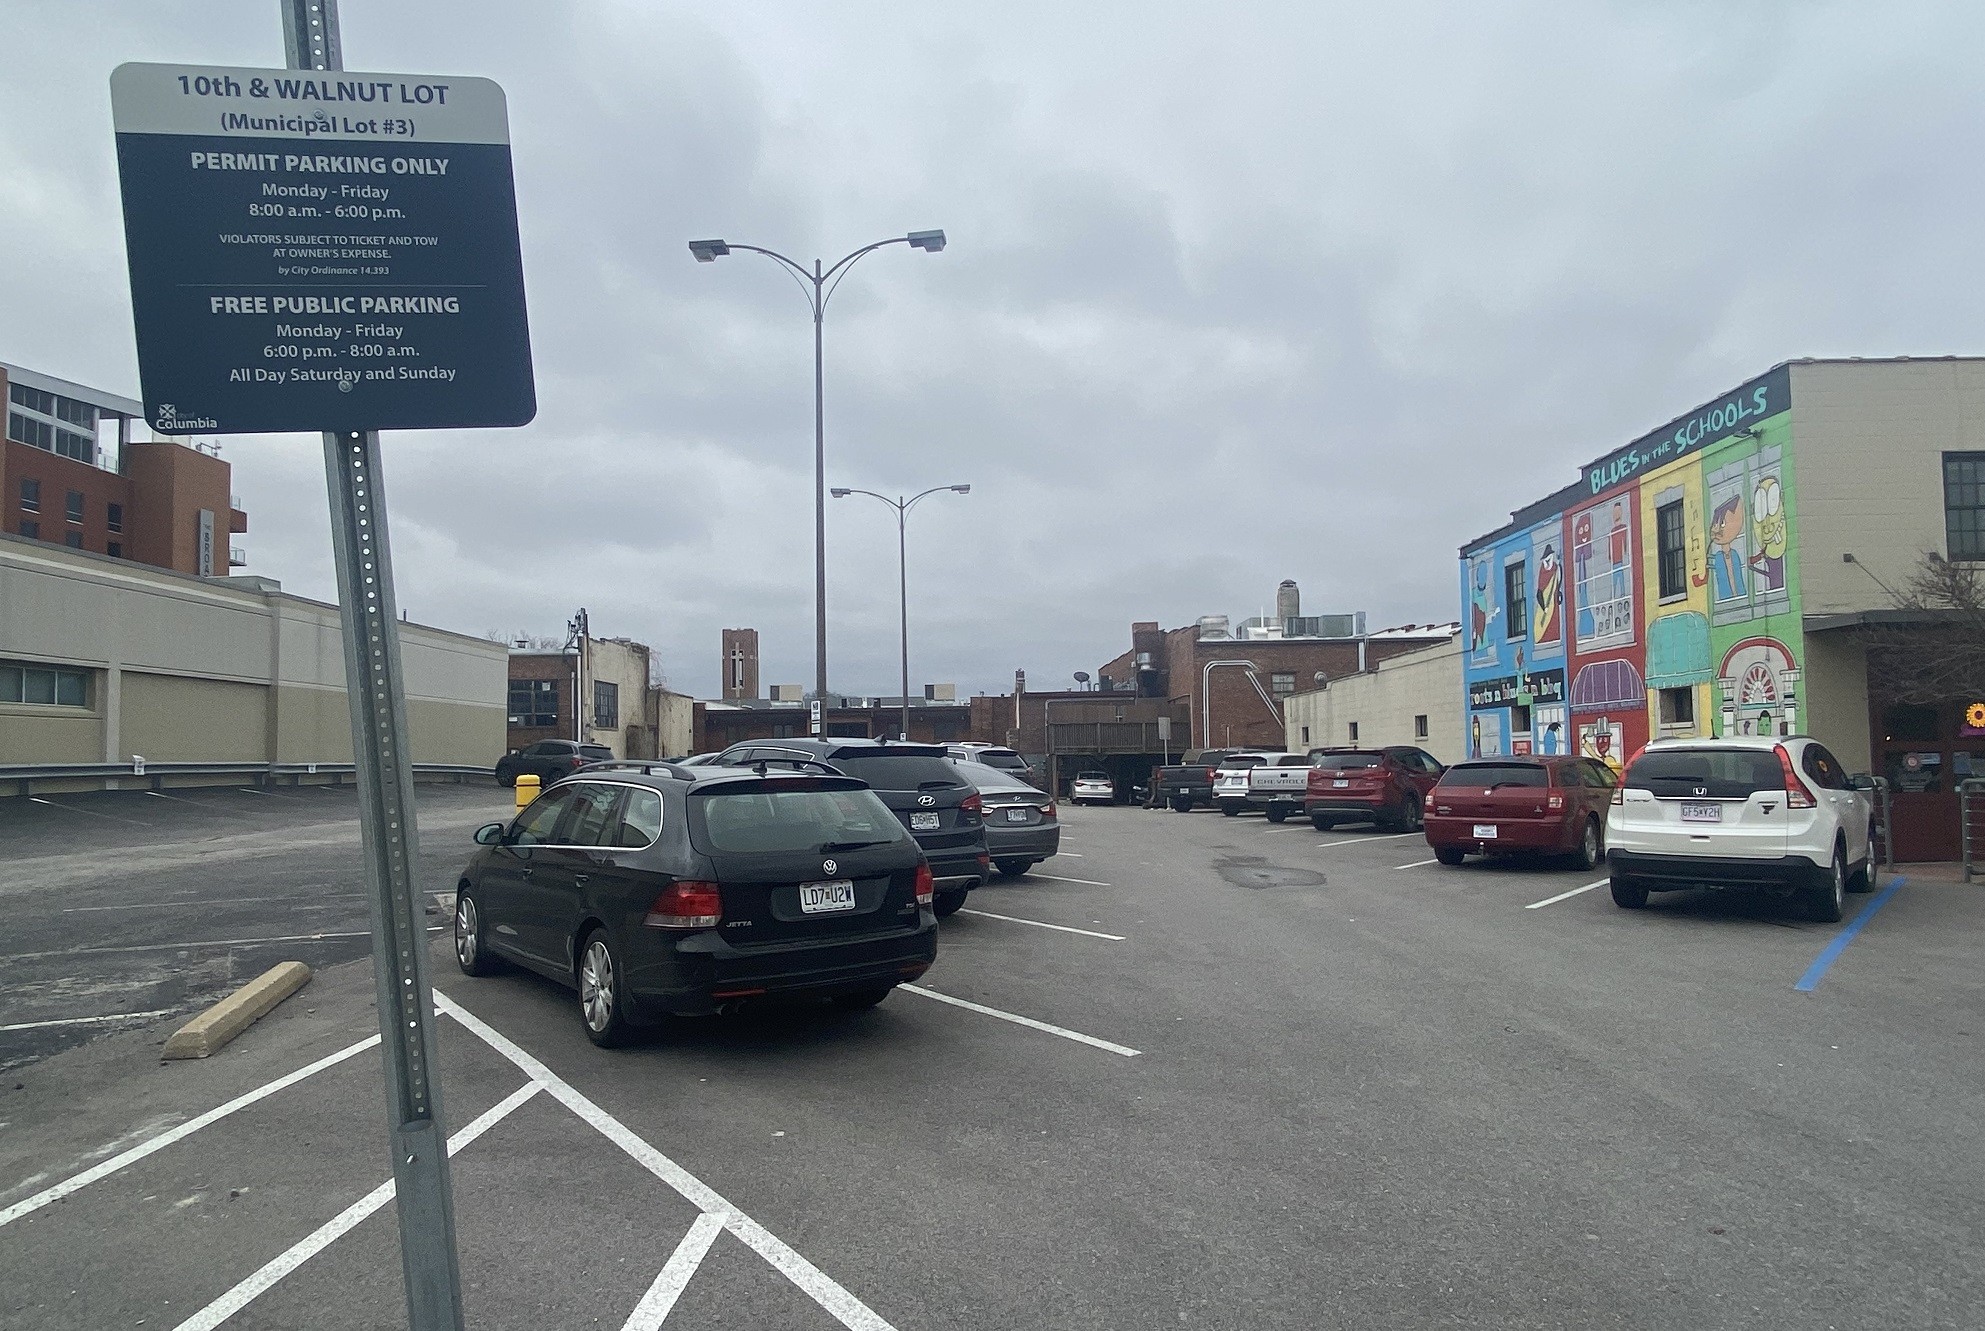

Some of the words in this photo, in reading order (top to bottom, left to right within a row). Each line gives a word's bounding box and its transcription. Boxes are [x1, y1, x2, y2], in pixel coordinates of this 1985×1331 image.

[178, 75, 242, 98] 10th
[249, 77, 270, 99] &
[274, 78, 393, 103] WALNUT
[400, 84, 449, 105] LOT
[221, 112, 337, 136] (Municipal
[343, 117, 377, 134] Lot
[383, 119, 415, 137] #3)
[191, 152, 280, 171] PERMIT
[285, 154, 387, 174] PARKING
[391, 157, 449, 175] ONLY
[262, 182, 328, 200] Monday
[341, 185, 389, 202] Friday
[249, 203, 284, 217] 8:00
[288, 206, 322, 218] a.m.
[334, 205, 368, 218] 6:00
[372, 208, 406, 221] p.m.
[219, 234, 282, 245] VIOLATORS
[284, 235, 332, 246] SUBJECT
[332, 235, 348, 246] TO
[348, 235, 386, 246] TICKET
[388, 236, 412, 246] AND
[413, 236, 439, 247] TOW
[272, 248, 287, 259] AT
[288, 248, 339, 259] OWNER'S
[341, 248, 392, 259] EXPENSE.
[278, 266, 290, 276] by
[291, 265, 309, 276] City
[311, 265, 358, 276] Ordinance
[360, 266, 389, 276] 14.393
[210, 296, 268, 314] FREE
[273, 296, 356, 314] PUBLIC
[361, 296, 460, 314] PARKING
[276, 323, 342, 340] Monday
[355, 323, 403, 339] Friday
[263, 344, 298, 358] 6:00
[303, 347, 337, 360] p.m.
[350, 344, 383, 357] 8:00
[387, 346, 420, 358] a.m.
[229, 368, 251, 382] All
[255, 368, 286, 384] Day
[290, 367, 361, 384] Saturday
[365, 366, 395, 380] and
[399, 366, 456, 382] Sunday
[156, 417, 218, 429] Columbia
[1590, 449, 1640, 495] BLUES
[1641, 454, 1650, 465] IN
[1652, 440, 1671, 459] THE
[1674, 386, 1768, 455] SCHOOLS
[1540, 677, 1562, 700] bbq
[803, 887, 825, 906] LD7
[725, 920, 752, 928] JETTA
